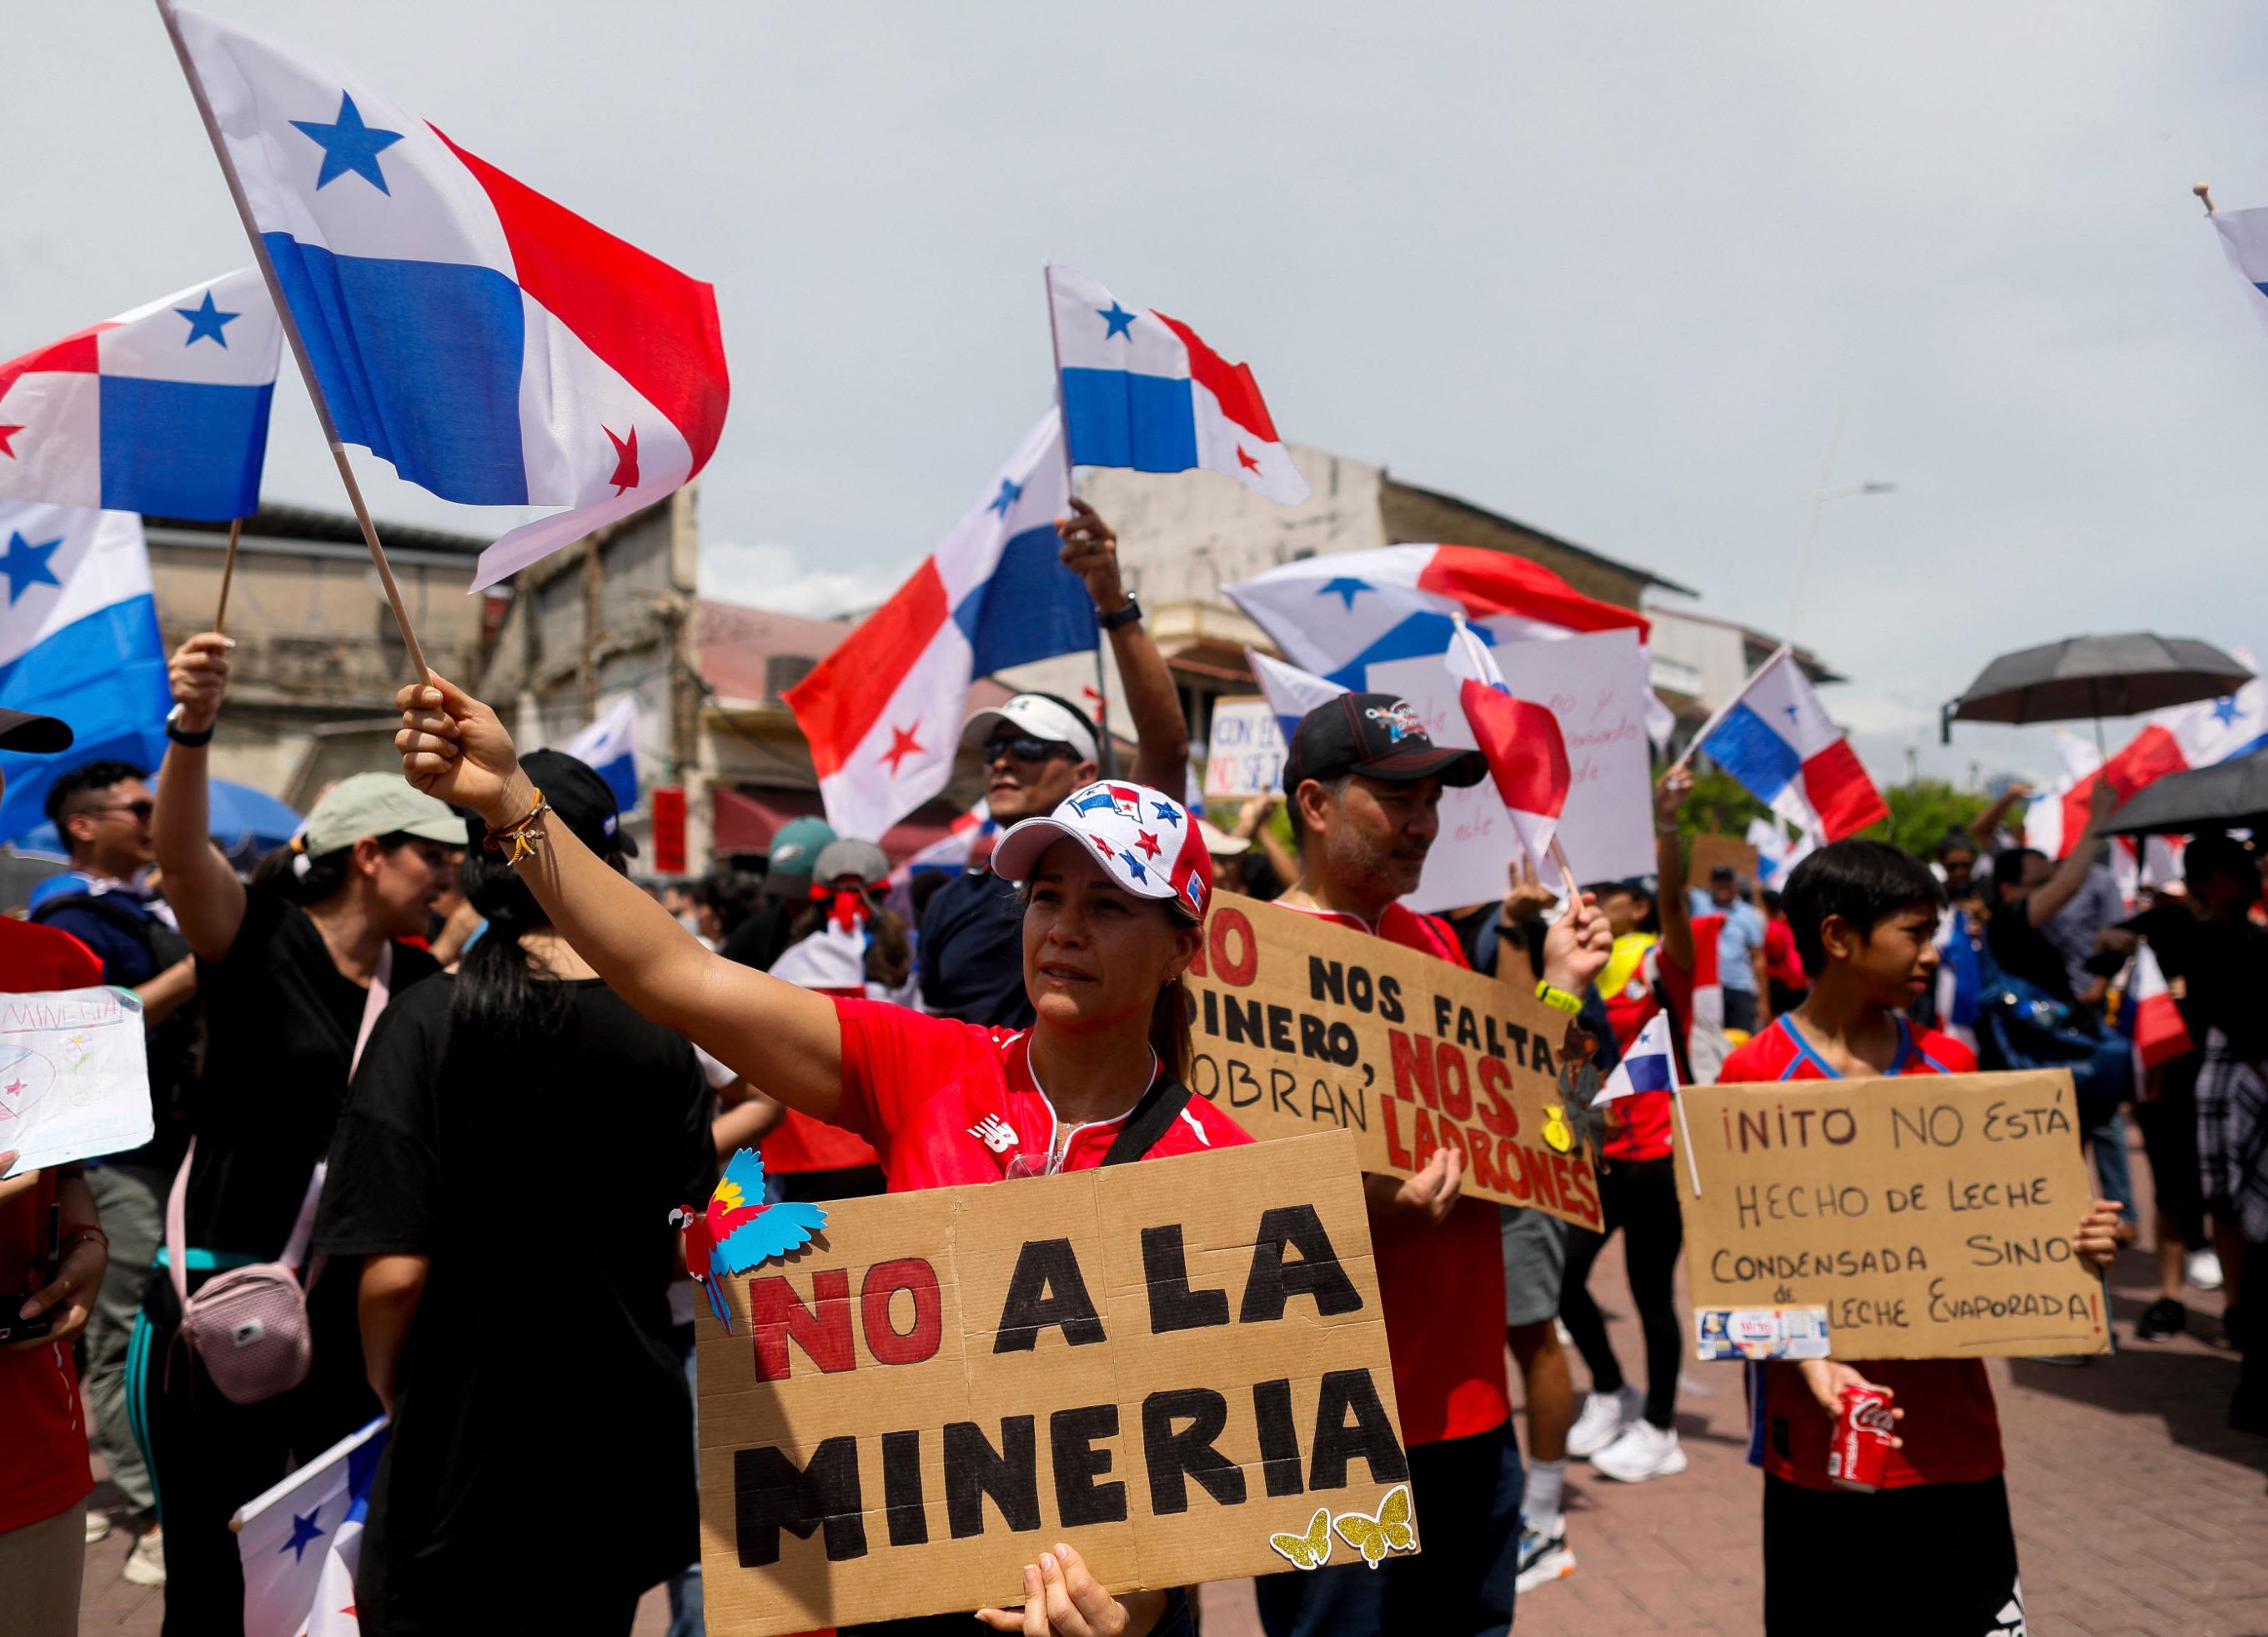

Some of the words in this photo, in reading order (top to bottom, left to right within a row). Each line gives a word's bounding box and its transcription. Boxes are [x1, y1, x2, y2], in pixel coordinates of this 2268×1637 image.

[1308, 955, 1405, 1025] NOS
[1433, 995, 1557, 1077] FALTA
[1388, 1028, 1519, 1138] NOS
[1890, 1104, 1964, 1149] NO
[1983, 1089, 2071, 1142] ESTÁ
[1191, 1053, 1367, 1132] OBRAN
[1381, 1093, 1600, 1227] LADRONES
[1735, 1182, 1869, 1229] HECHO
[1886, 1184, 1928, 1213] DE
[1948, 1177, 2053, 1212] LECHE
[748, 1258, 942, 1383] NO
[992, 1236, 1107, 1354] A
[1141, 1203, 1363, 1335] LA
[1710, 1246, 1928, 1284] CONDENSADA
[1965, 1233, 2071, 1268] SINO
[1773, 1281, 1797, 1305] de
[1827, 1298, 1910, 1331] LECHE
[1928, 1277, 2103, 1334] EVAPORADA!
[733, 1368, 1411, 1569] MINERIA
